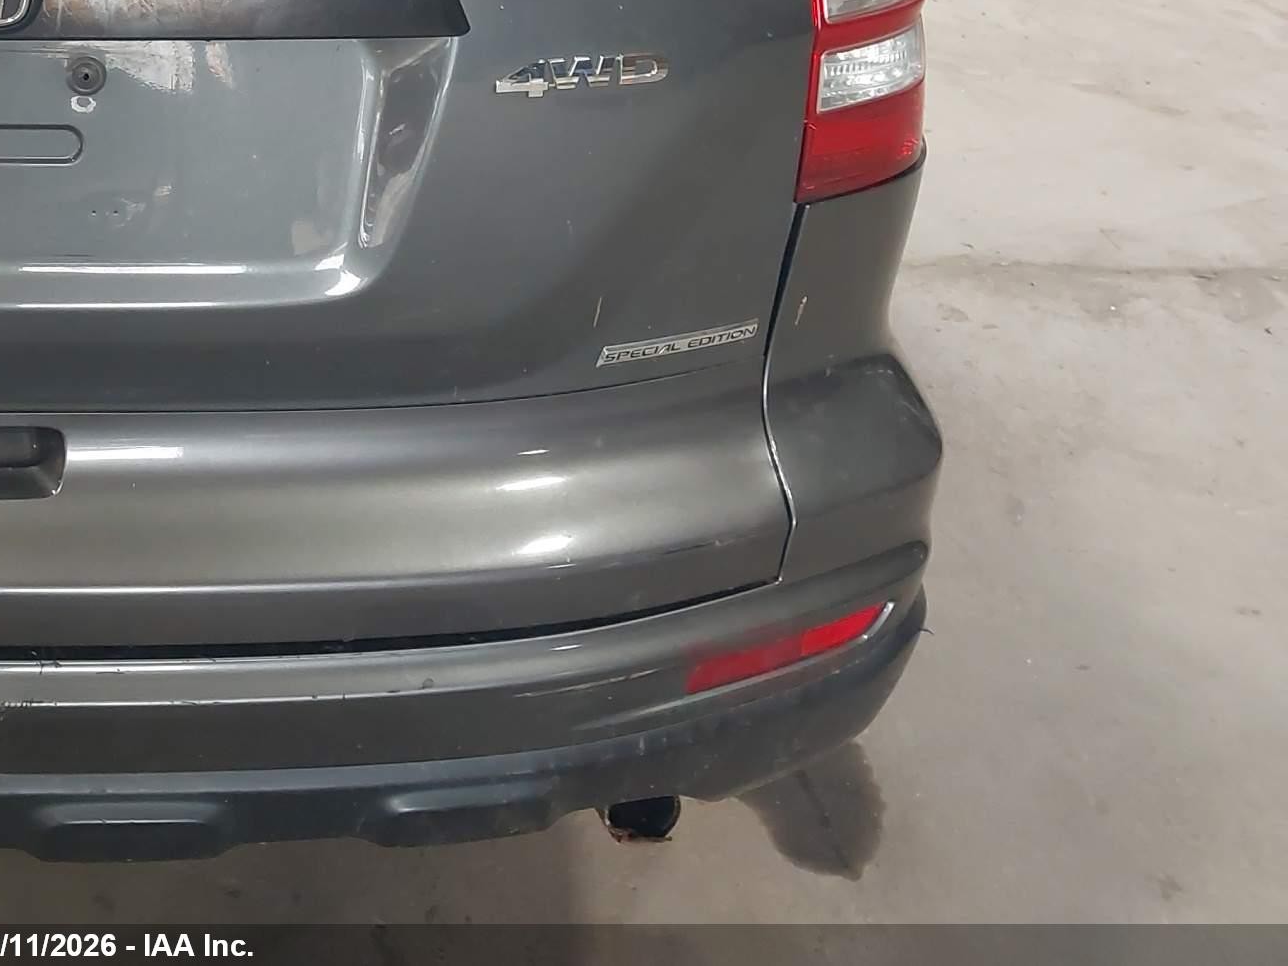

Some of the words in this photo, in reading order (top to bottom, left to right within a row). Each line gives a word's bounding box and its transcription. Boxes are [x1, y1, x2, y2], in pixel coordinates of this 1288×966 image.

[496, 52, 669, 98] 4WD
[603, 343, 681, 364] SPECIAL
[687, 326, 757, 349] EDITION
